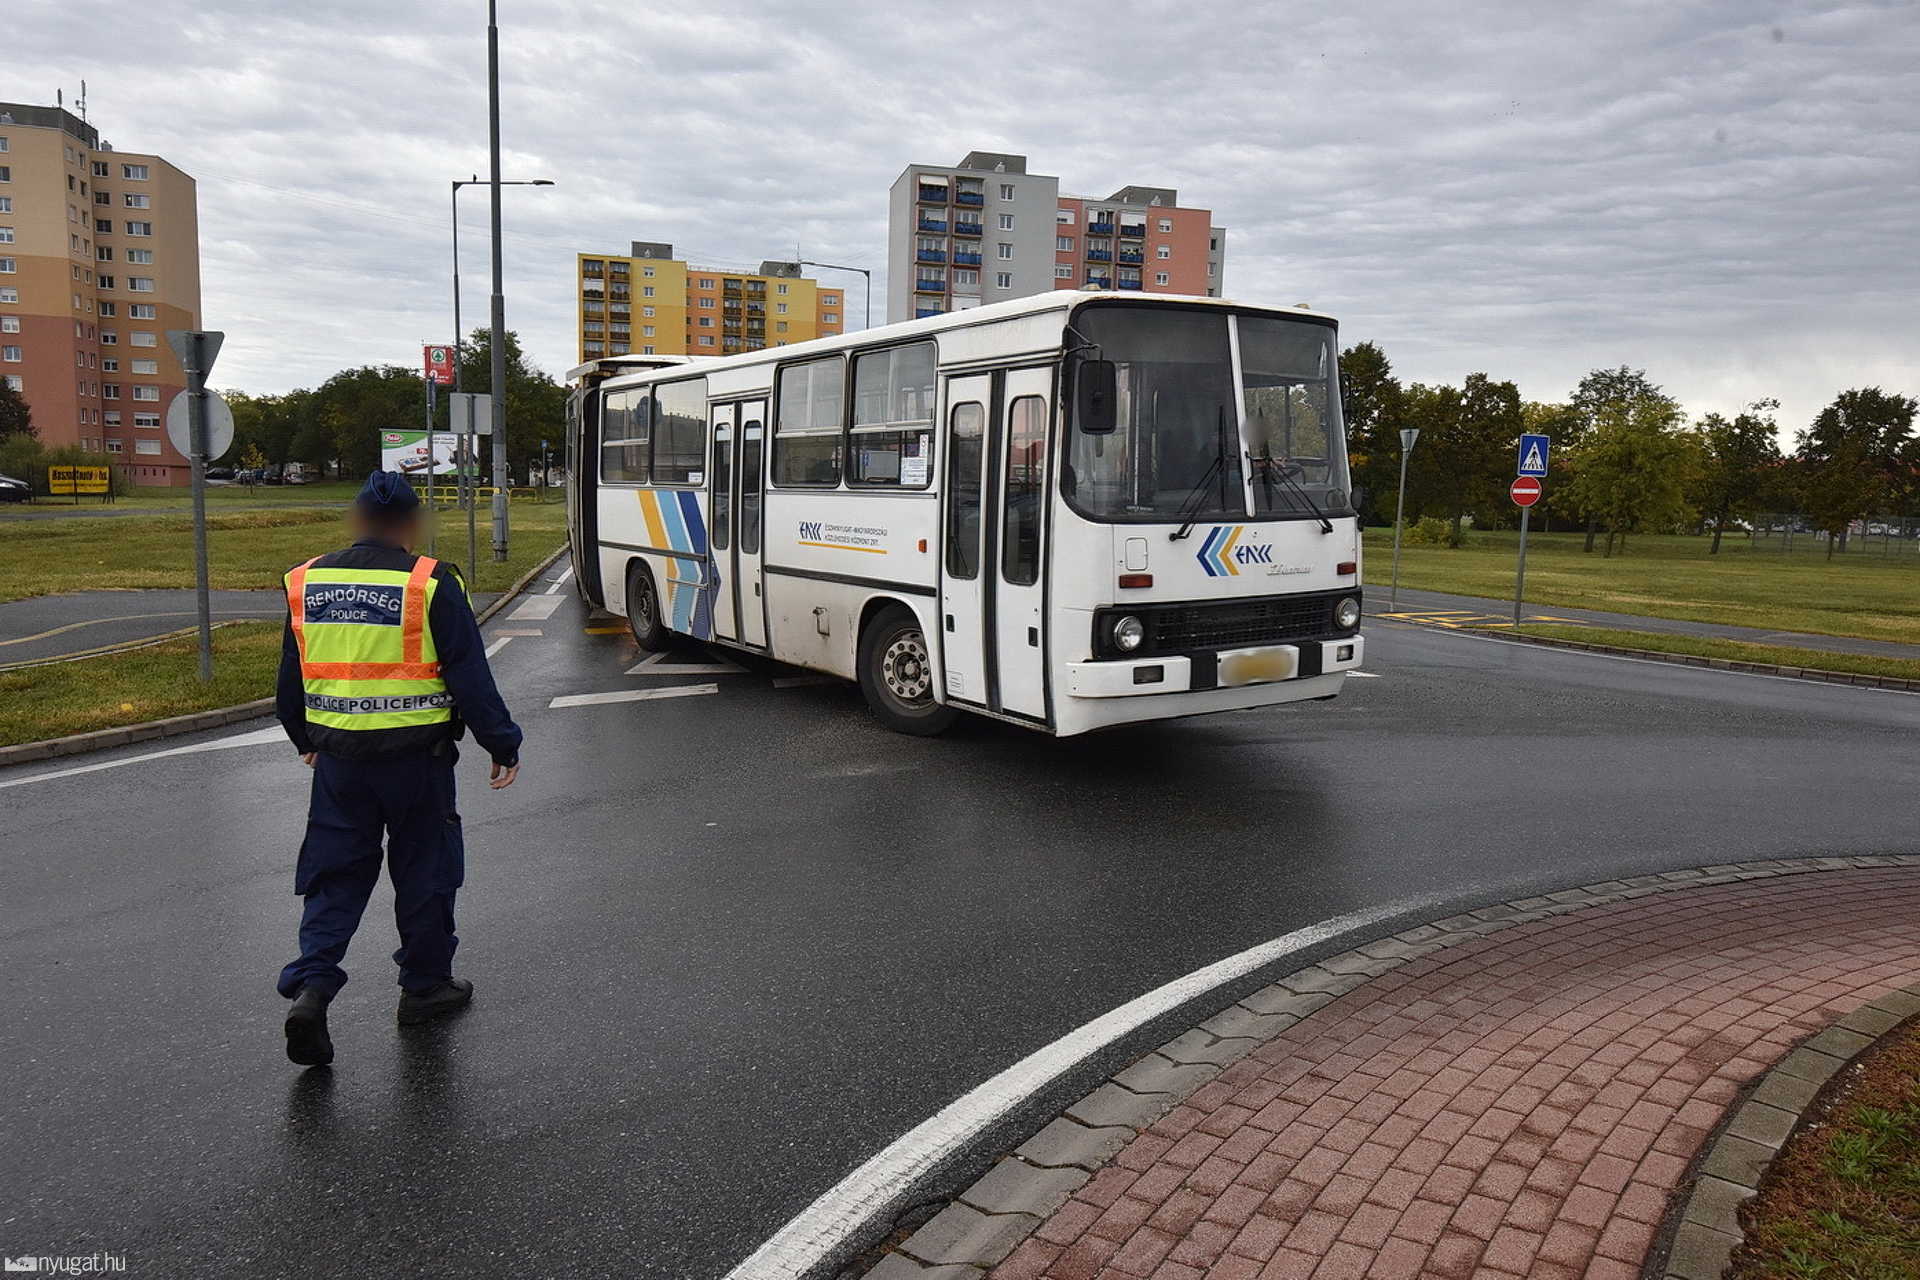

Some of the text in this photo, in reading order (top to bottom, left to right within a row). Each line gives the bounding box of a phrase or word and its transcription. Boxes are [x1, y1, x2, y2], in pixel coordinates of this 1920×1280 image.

[306, 585, 401, 612] RENDŐRSÉG
[331, 609, 368, 620] POLICE
[308, 696, 345, 711] POLICE
[349, 698, 411, 712] POLICE
